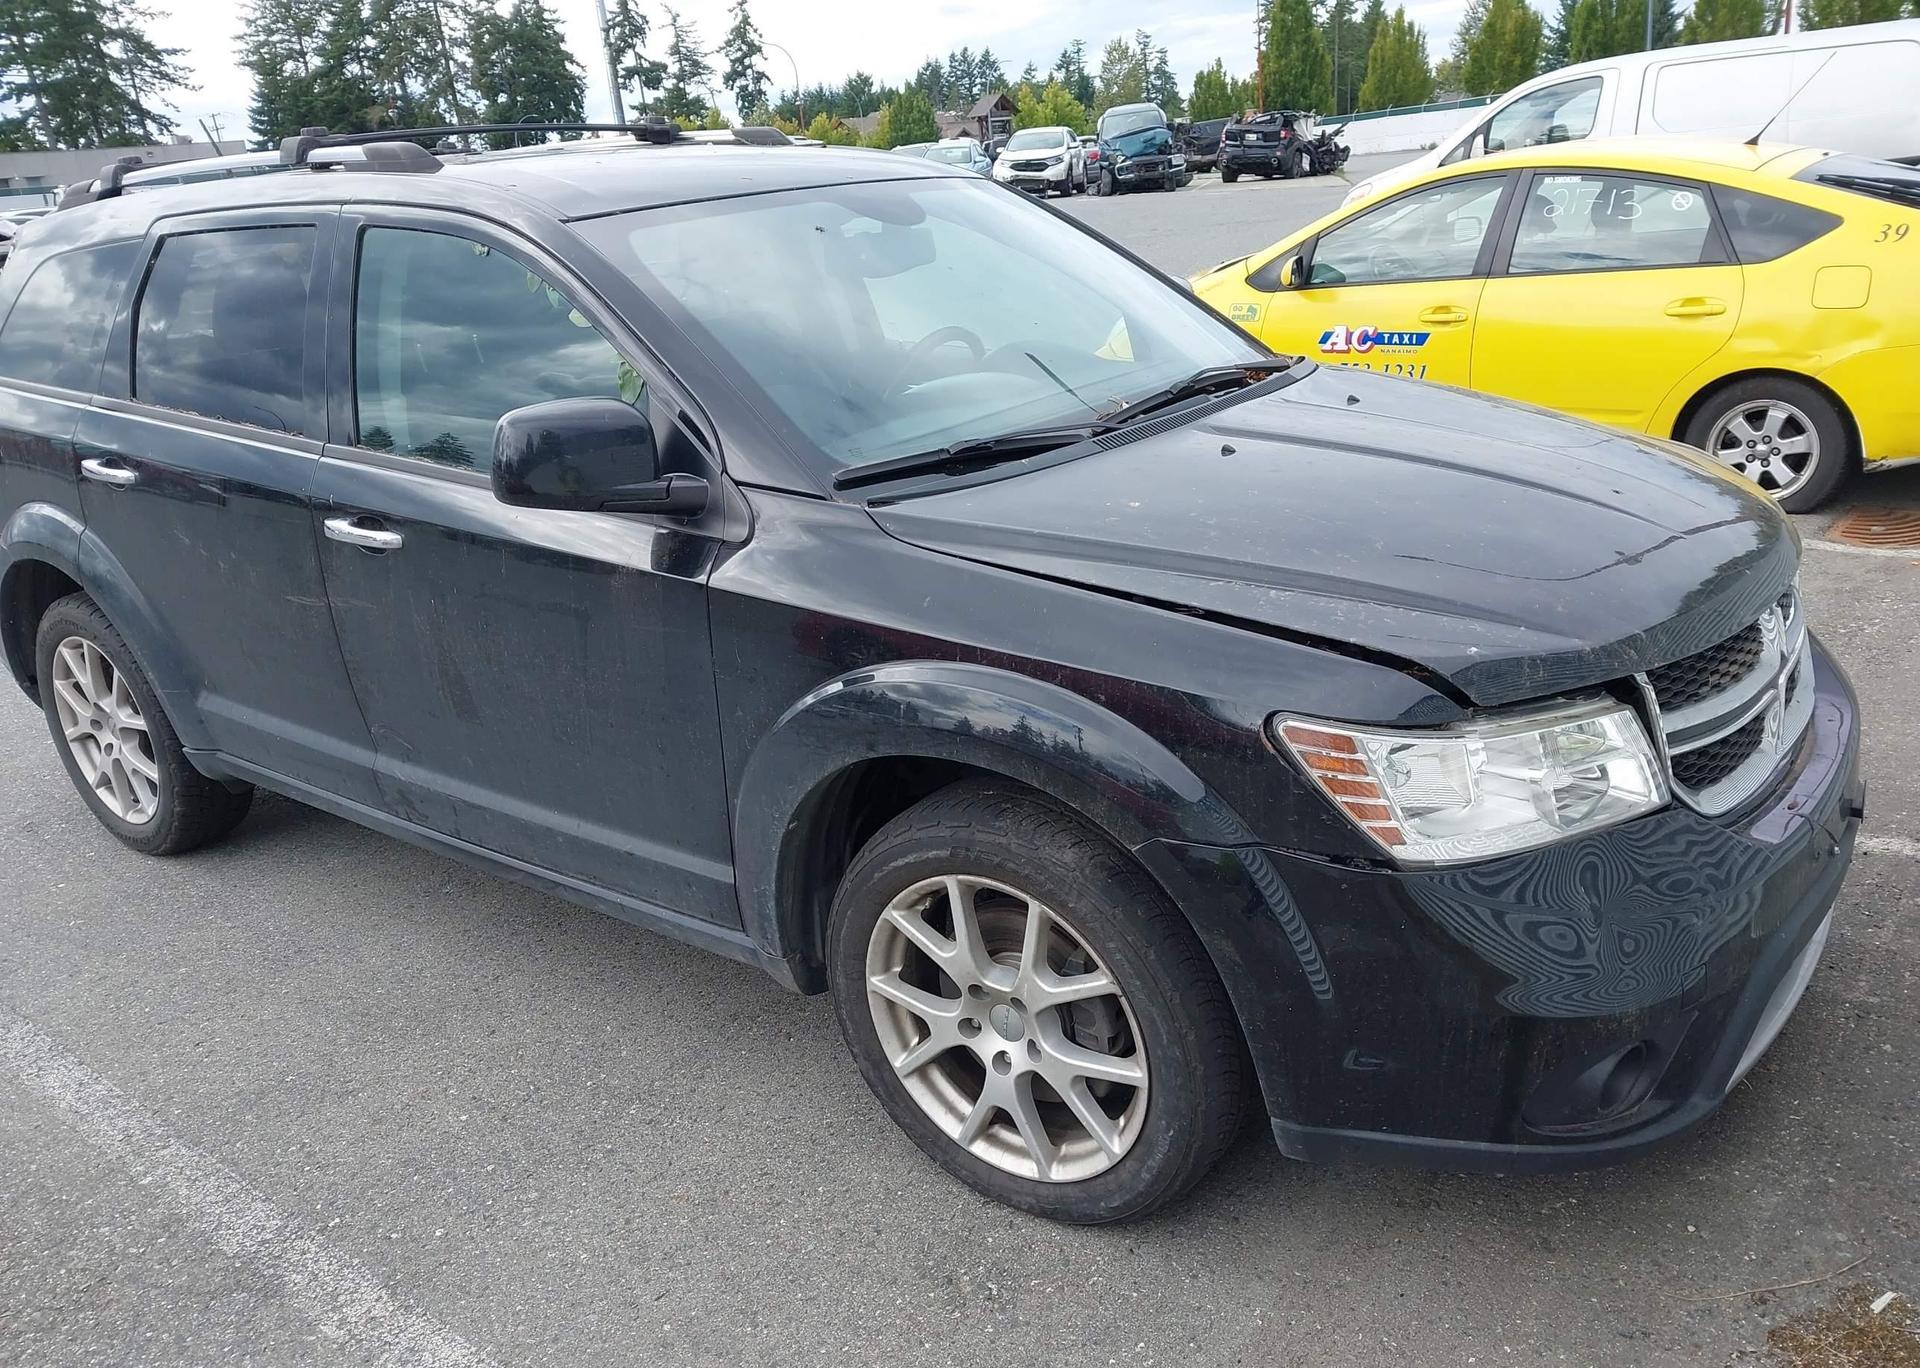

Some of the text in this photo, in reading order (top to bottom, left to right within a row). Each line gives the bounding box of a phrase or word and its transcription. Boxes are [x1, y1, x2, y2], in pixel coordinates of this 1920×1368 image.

[1873, 223, 1910, 243] 39
[1321, 324, 1417, 354] AC TAXI
